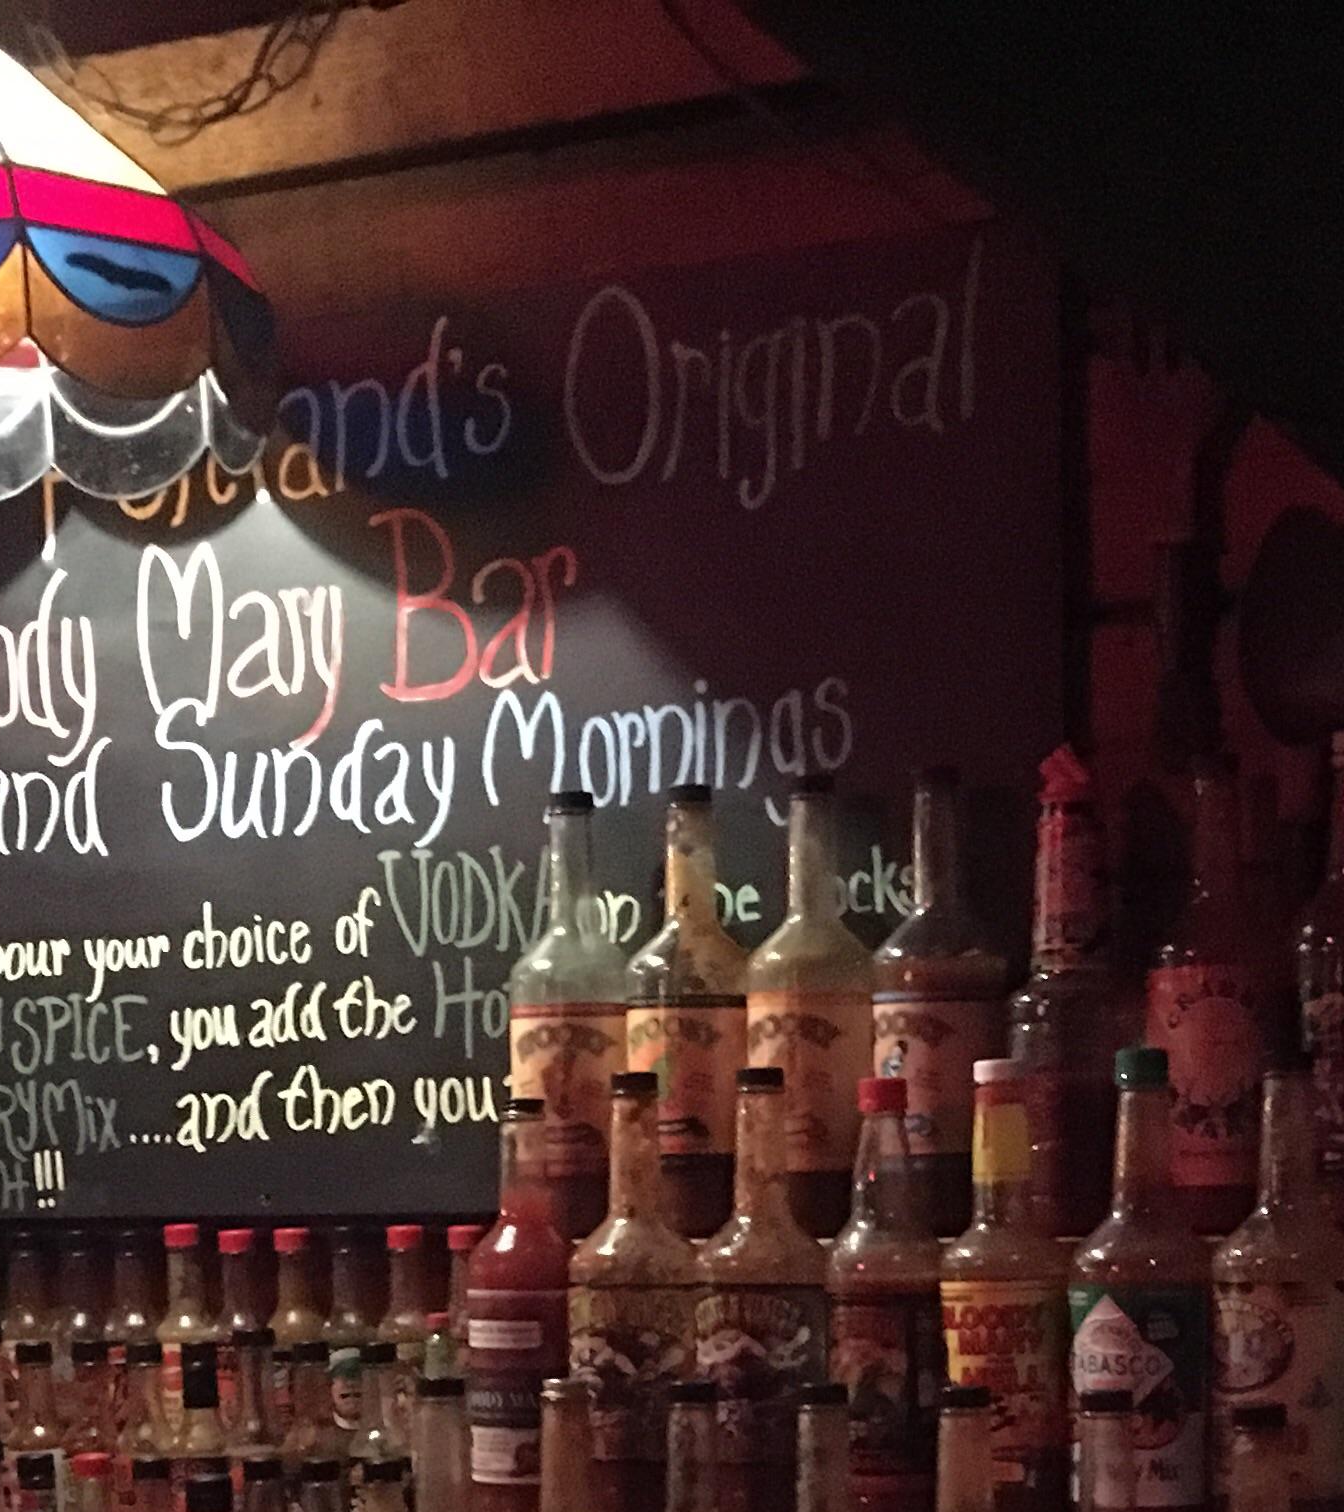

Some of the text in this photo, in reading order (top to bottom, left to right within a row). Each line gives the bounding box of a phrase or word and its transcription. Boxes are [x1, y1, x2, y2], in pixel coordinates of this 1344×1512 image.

[563, 234, 987, 510] Original
[136, 541, 343, 748] Mary
[368, 507, 577, 702] Bar
[154, 697, 456, 848] Sunday
[83, 935, 171, 1003] your
[182, 900, 312, 979] choice
[335, 886, 382, 958] of
[169, 999, 239, 1071] you
[250, 982, 325, 1048] add
[334, 978, 419, 1043] the
[433, 953, 510, 1060] Ho
[279, 1065, 395, 1134] then
[412, 1073, 513, 1143] you
[1075, 1352, 1163, 1377] ABASCO
